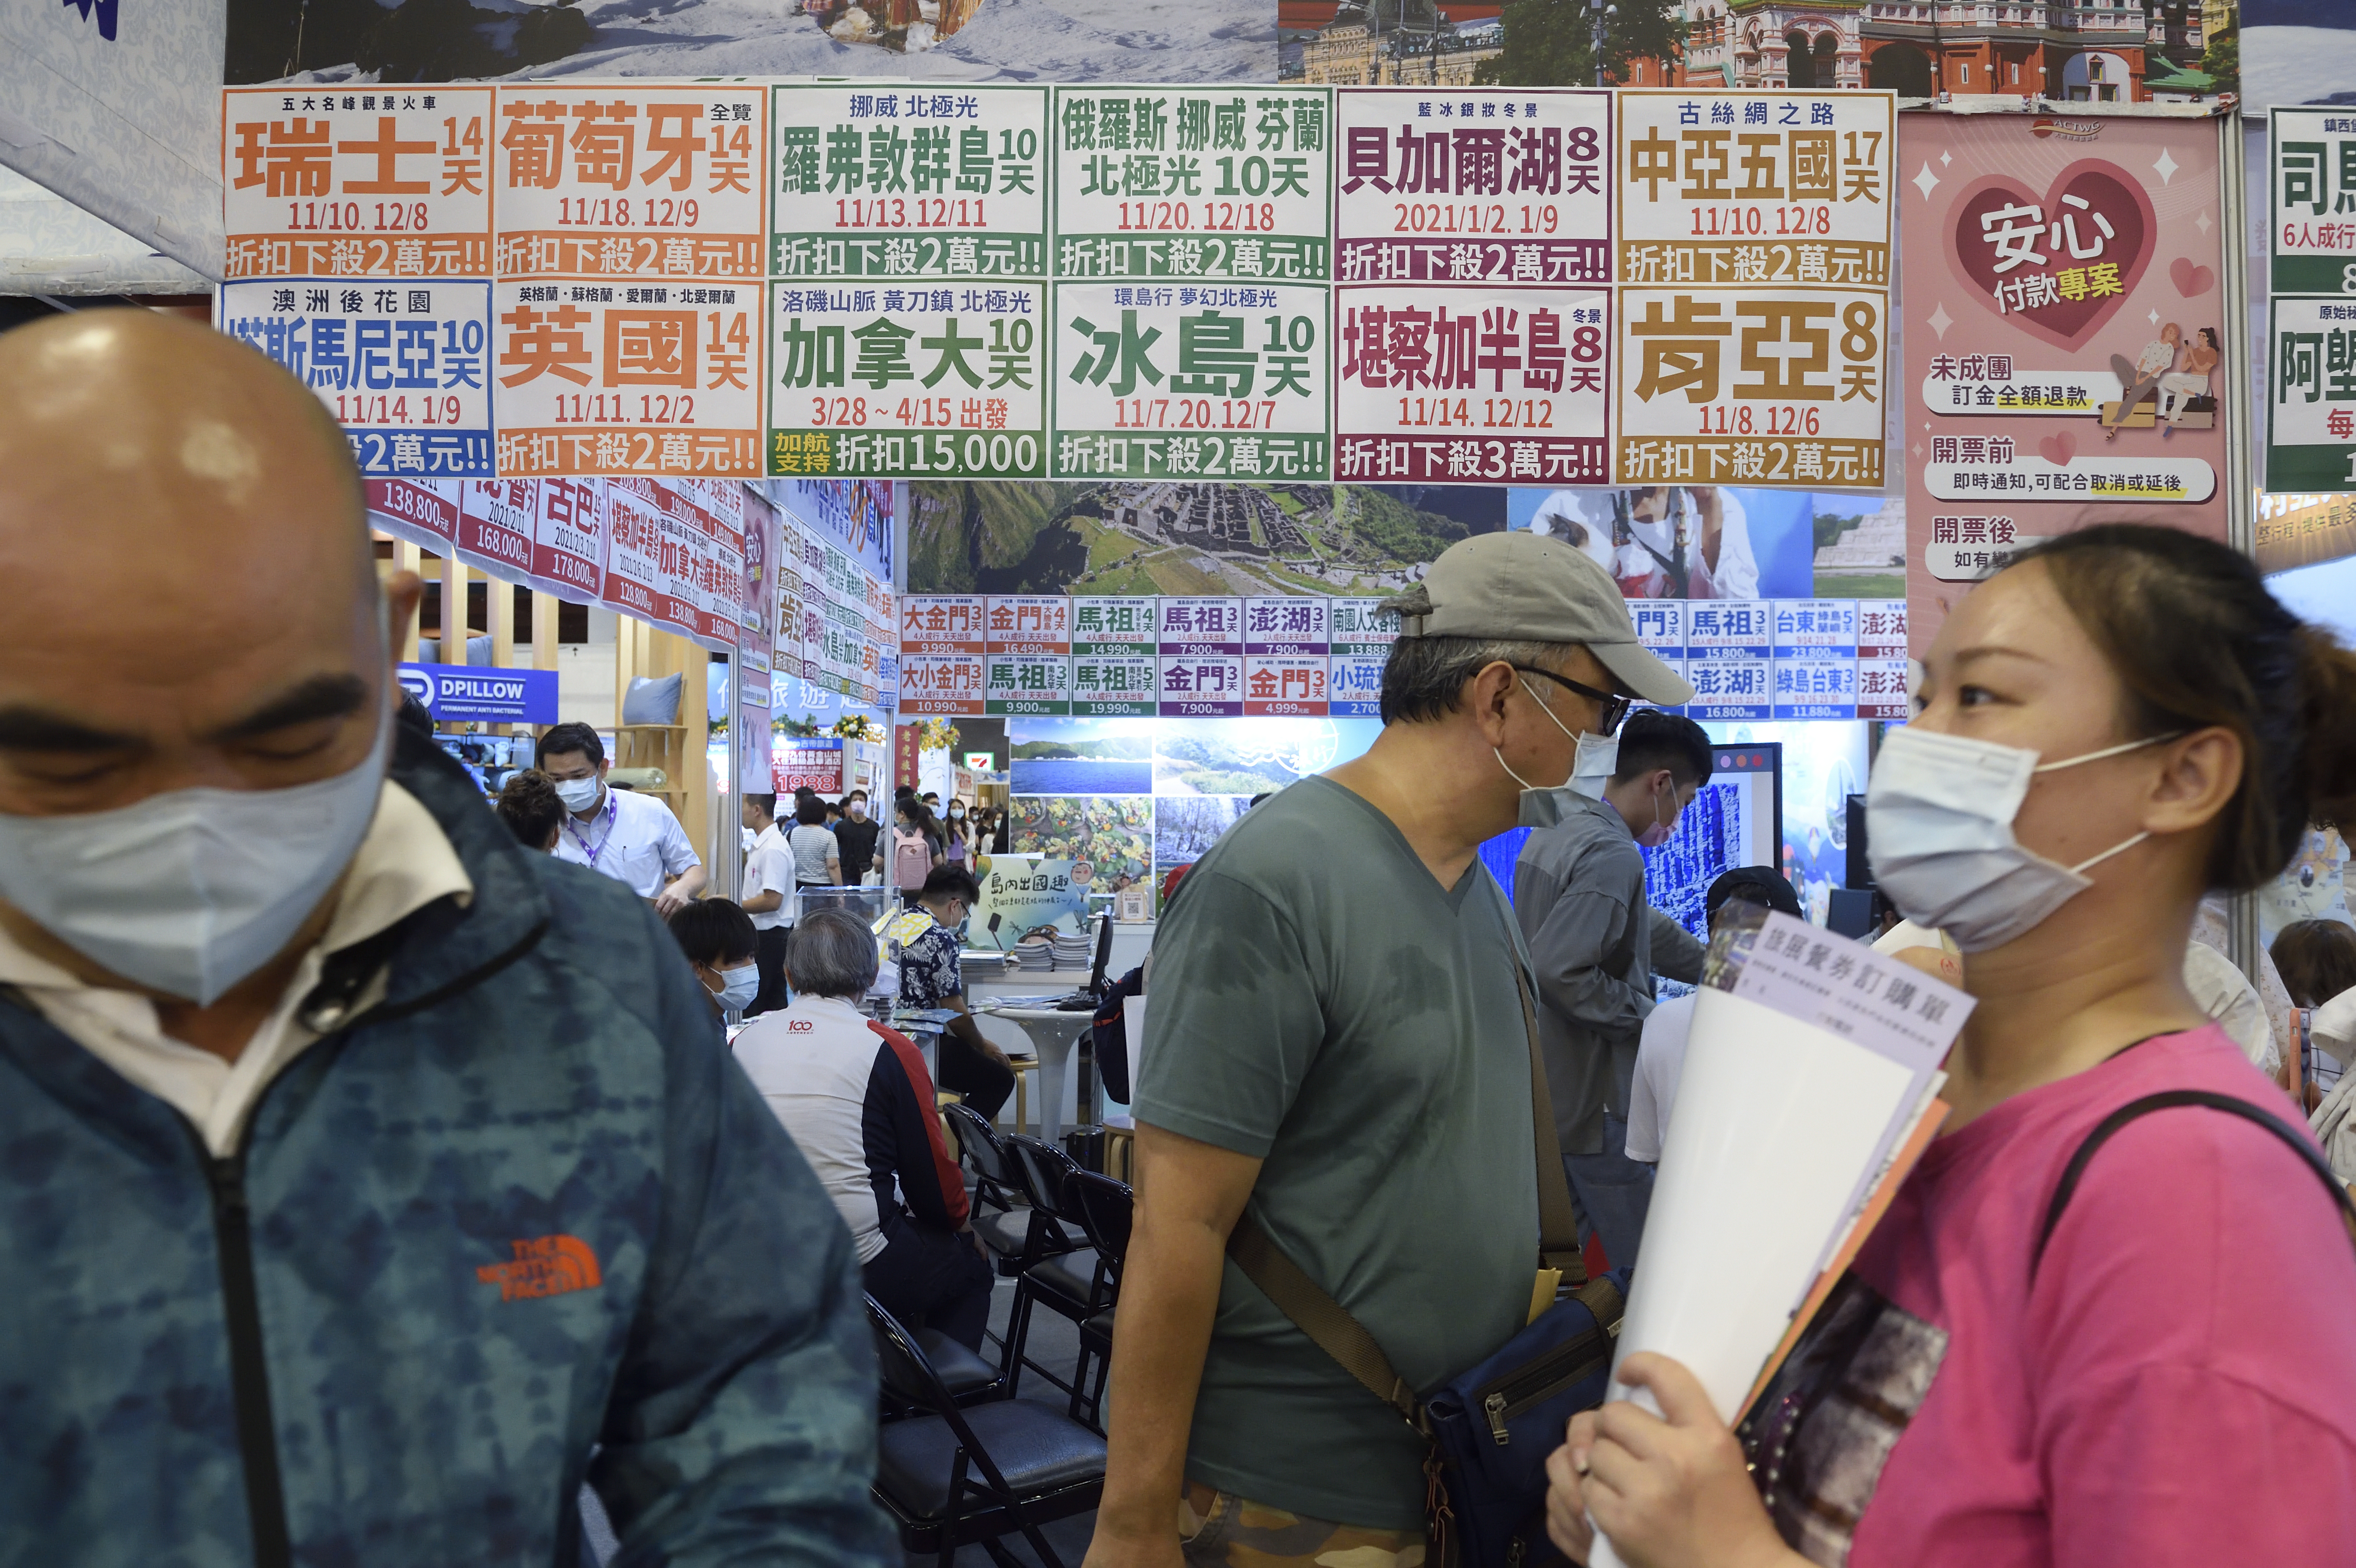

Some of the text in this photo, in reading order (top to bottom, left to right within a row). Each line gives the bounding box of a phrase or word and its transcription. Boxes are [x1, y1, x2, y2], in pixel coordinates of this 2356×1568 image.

[710, 104, 752, 120] 全覽
[850, 95, 978, 118] 挪威 北極光
[1418, 102, 1537, 118] 藍冰銀妝冬景
[1679, 101, 1834, 126] 古絲綢之路
[443, 116, 483, 155] 14
[1062, 97, 1324, 153] 俄羅斯 挪威 芬蘭
[2054, 119, 2100, 132] ACTWG
[234, 118, 436, 197] 瑞士
[501, 101, 706, 190] 葡萄牙
[709, 125, 751, 159] 14
[999, 129, 1035, 161] 10
[1567, 127, 1599, 160] 8
[1844, 131, 1882, 165] 17
[782, 125, 994, 195] 羅弗敦群島
[1342, 126, 1562, 196] 貝加爾湖
[1630, 126, 1837, 203] 中亞五國
[442, 160, 483, 196] 天
[708, 162, 750, 194] 天
[999, 165, 1035, 195] 天
[1081, 155, 1309, 198] 北極光 10天
[1567, 164, 1600, 195] 天
[1843, 168, 1880, 204] 天
[374, 202, 428, 229] 12/8
[644, 199, 698, 228] 12/9
[1204, 203, 1274, 232] 12/18
[1521, 206, 1558, 234] 1/9
[1776, 207, 1830, 235] 12/8
[1981, 194, 2115, 274] 安心
[2284, 222, 2356, 250] 6人成行
[227, 239, 485, 275] 折扣下殺2萬元!!
[498, 237, 758, 274] 折扣下殺2萬元!!
[777, 237, 1040, 275] 折扣下殺2萬元!!
[1061, 240, 1324, 277] 折扣下殺2萬元!!
[1342, 243, 1604, 281] 折扣下殺2萬元!!
[1626, 246, 1885, 283] 折扣下殺2萬元!!
[273, 290, 431, 313] 澳洲後花園
[782, 290, 1031, 314] 洛磯山脈 黃刀鎮 北極光
[1114, 288, 1277, 308] 環島行 夢幻北極光
[1994, 262, 2124, 314] 付款專案
[1572, 308, 1602, 323] 冬景
[442, 320, 484, 353] 10
[499, 305, 698, 389] 英國
[706, 312, 749, 353] 14
[989, 318, 1033, 353] 10
[1264, 316, 1315, 352] 10
[1571, 327, 1602, 363] 8
[1840, 302, 1878, 362] 8
[781, 317, 984, 390] 加拿大
[1069, 310, 1258, 399] 冰島
[1342, 305, 1566, 393] 堪察加半島
[1630, 295, 1836, 403] 肯亞
[442, 357, 484, 390] 天
[706, 355, 749, 391] 天
[988, 355, 1034, 390] 天
[1265, 355, 1310, 397] 天
[1570, 368, 1601, 393] 天
[1931, 355, 2011, 381] 未成團
[1839, 366, 1877, 403] 天
[1952, 384, 2087, 407] 訂金全額退款
[423, 396, 460, 425] 1/9
[641, 394, 694, 424] 12/2
[812, 398, 1008, 428] 3/28 4/15 出發
[1484, 399, 1552, 428] 12/12
[1767, 407, 1820, 436] 12/6
[499, 432, 754, 471] 折扣下殺2萬元!!
[775, 433, 829, 453] 加航
[836, 435, 1037, 472] 折扣15,000
[1059, 435, 1323, 474] 折扣下殺2萬元!!
[1932, 437, 2014, 464] 開票前
[775, 453, 829, 472] 支持
[1341, 440, 1602, 479] 折扣下殺3萬元!!
[1625, 441, 1880, 481] 折扣下殺2萬元!!
[1934, 518, 2015, 544] 開票後
[905, 605, 970, 631] 大金門
[990, 605, 1042, 631] 金門
[1075, 606, 1134, 632] 馬祖
[1163, 606, 1225, 632] 馬祖
[1249, 607, 1310, 632] 澎湖
[1691, 610, 1753, 636] 馬祖
[1777, 610, 1815, 633] 台東
[441, 680, 524, 699] DPILLOW
[903, 663, 970, 689] 大小金門
[988, 664, 1047, 690] 馬祖
[1074, 665, 1128, 691] 馬祖
[1164, 665, 1224, 691] 金門
[1249, 668, 1310, 698] 金門
[1692, 669, 1753, 694] 澎湖
[991, 872, 1069, 894] 島內出國趣
[789, 1020, 812, 1031] 100
